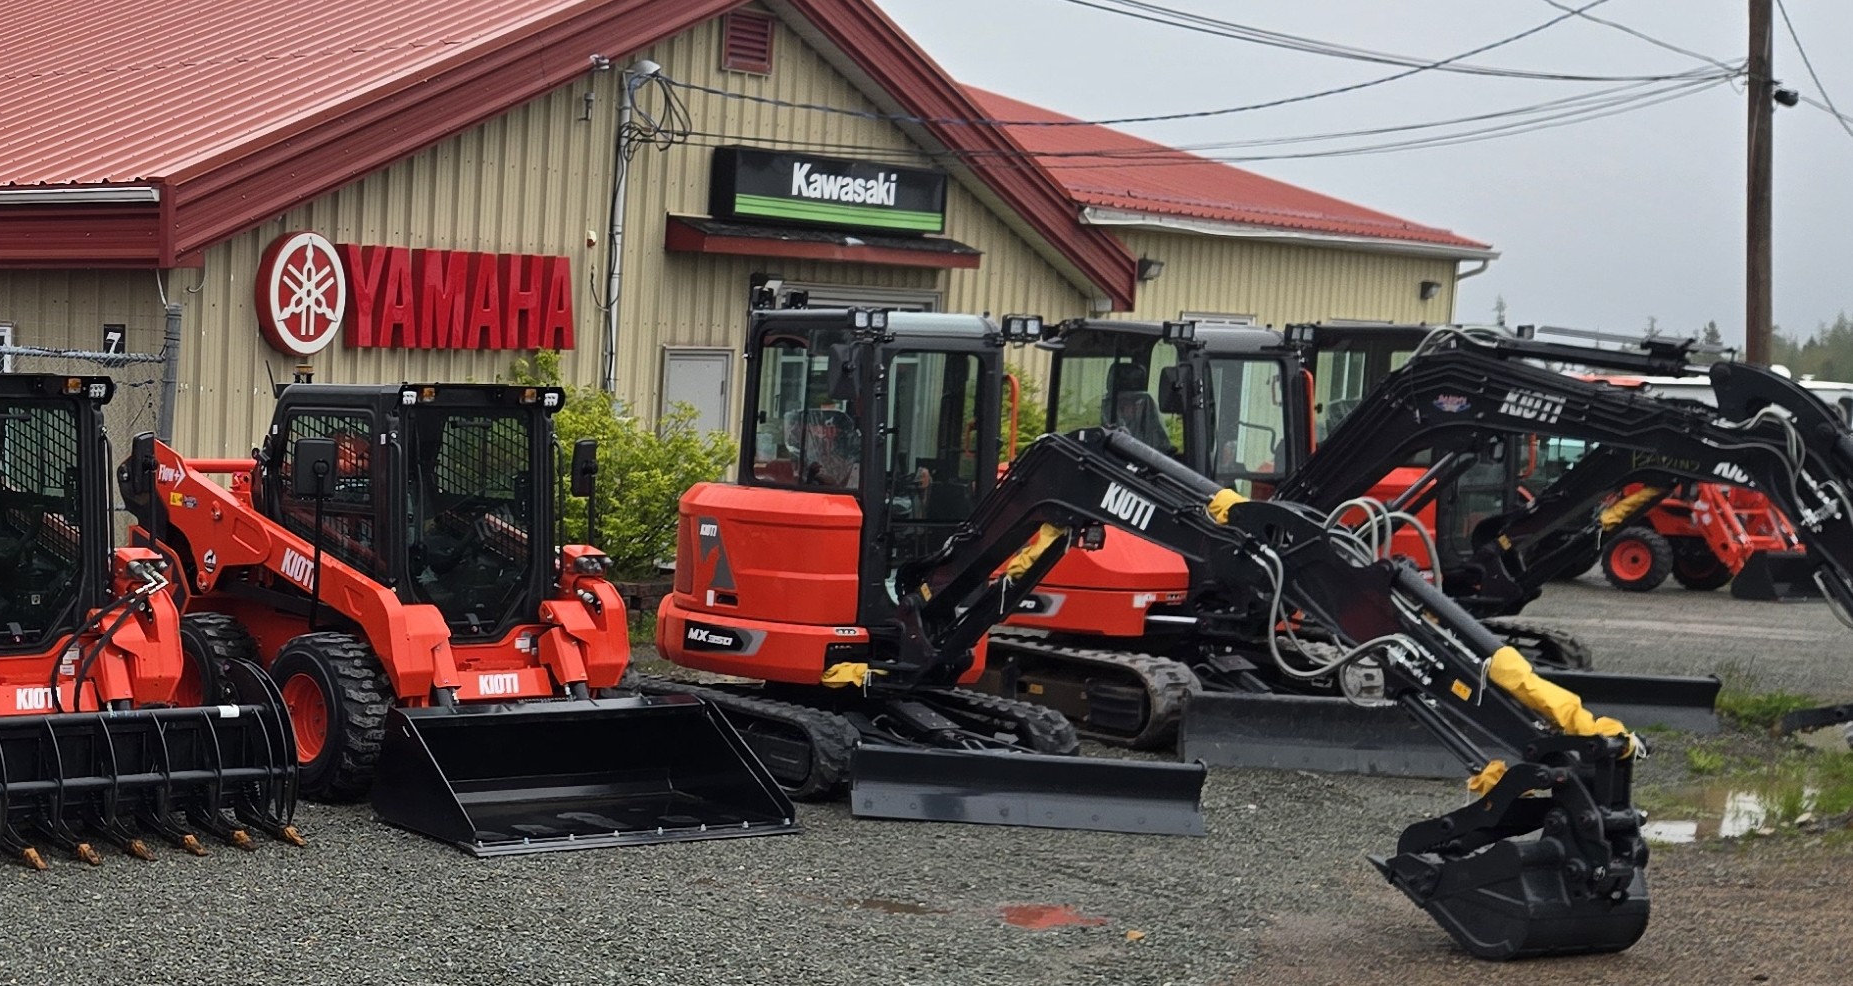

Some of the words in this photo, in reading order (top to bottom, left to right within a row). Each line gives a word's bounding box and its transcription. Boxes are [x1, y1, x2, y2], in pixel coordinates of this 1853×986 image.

[792, 162, 897, 206] Kawasaki
[344, 244, 575, 350] YAMAHA
[105, 331, 122, 354] 7
[1100, 481, 1156, 531] KIOTI
[478, 672, 520, 696] KIOTI
